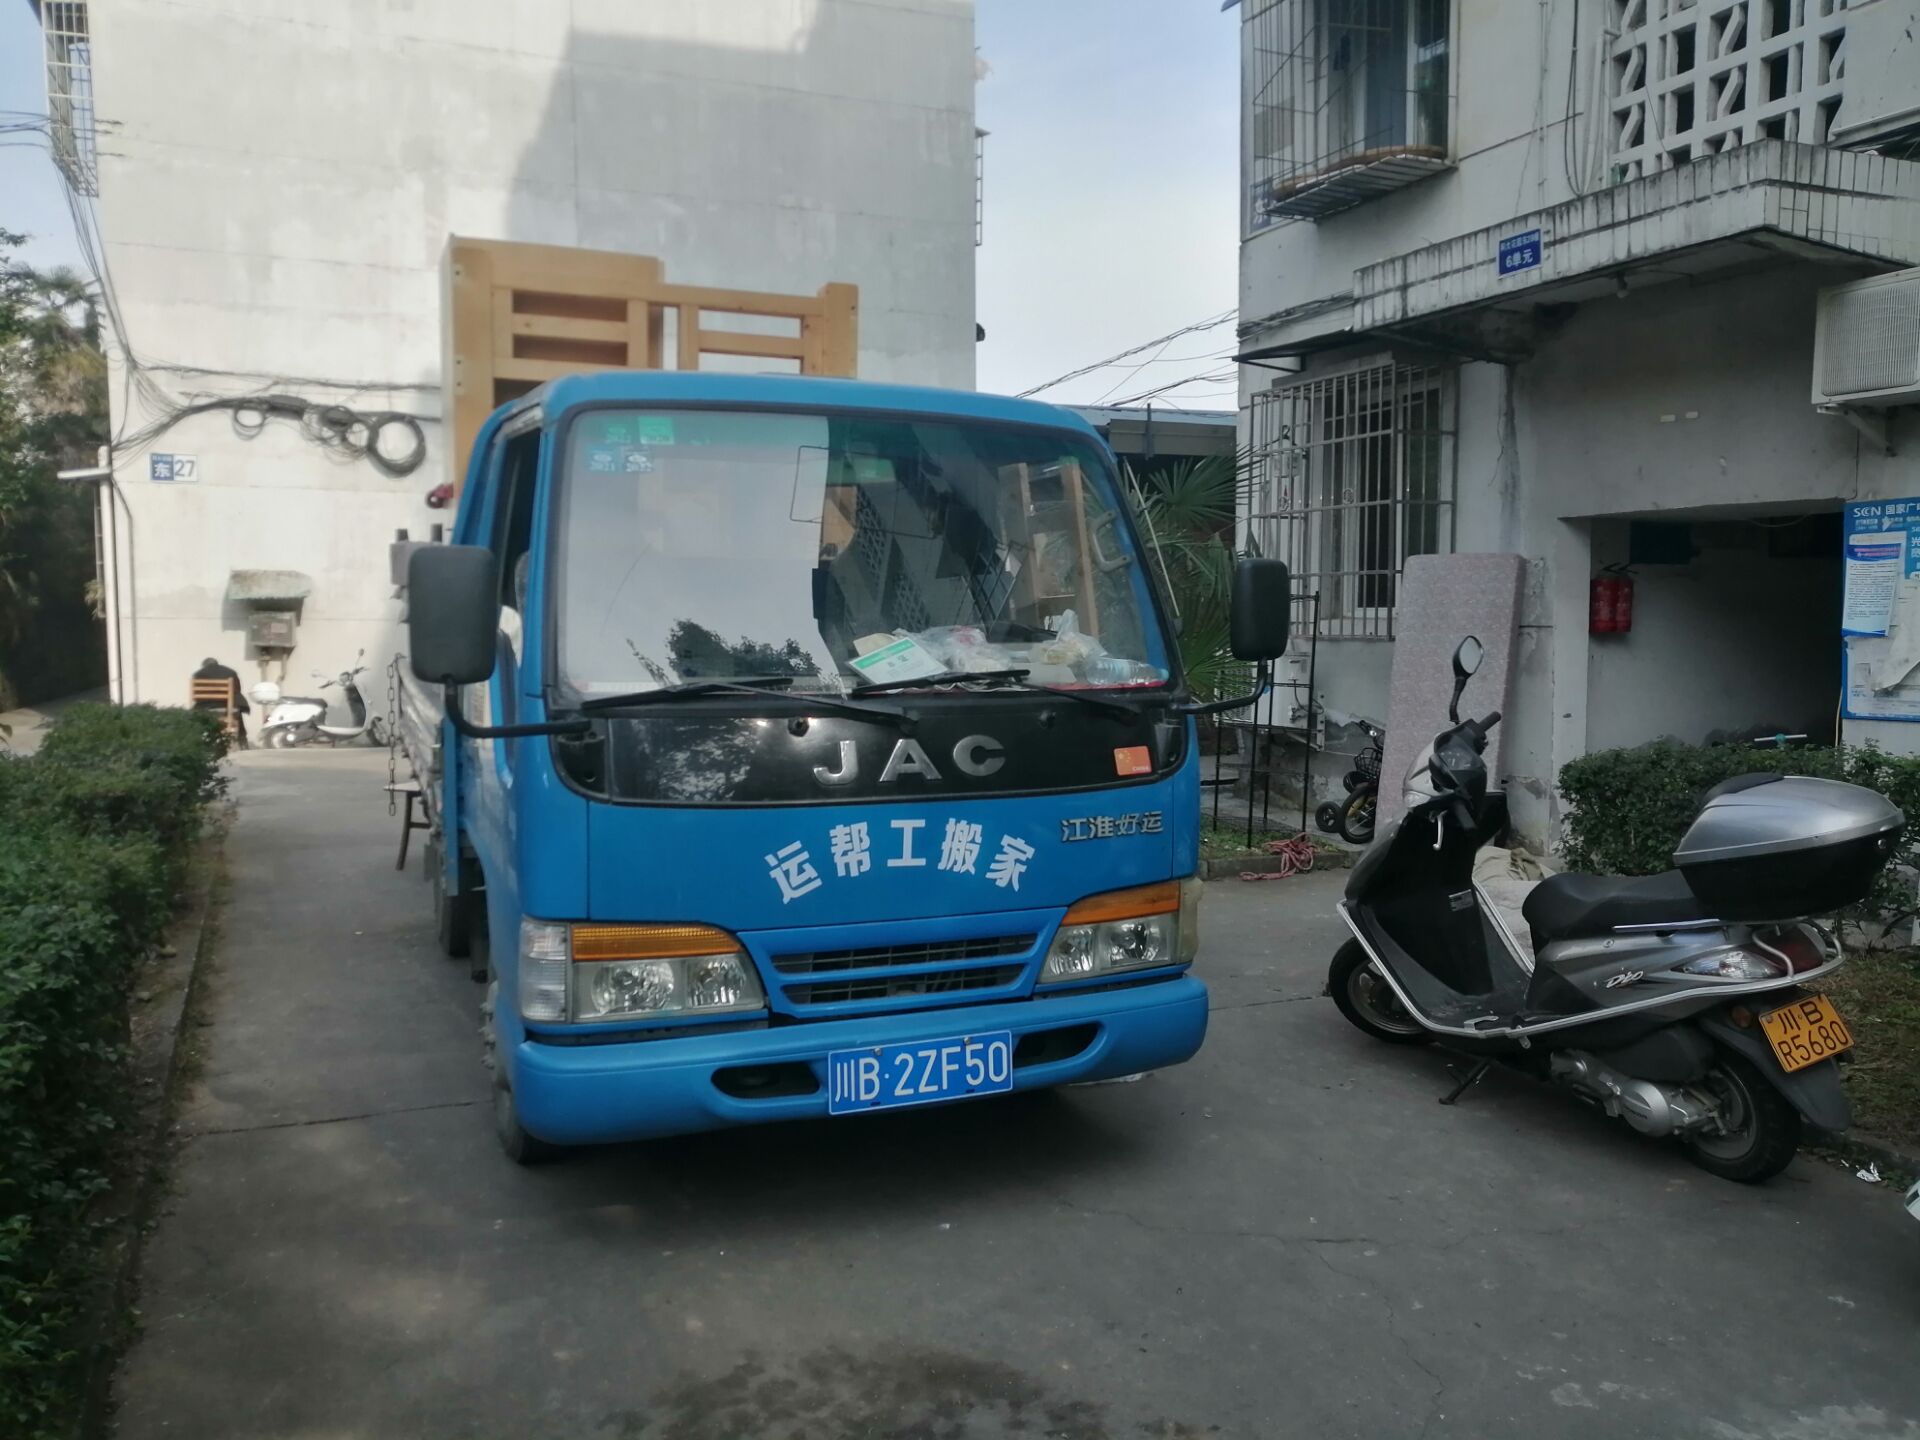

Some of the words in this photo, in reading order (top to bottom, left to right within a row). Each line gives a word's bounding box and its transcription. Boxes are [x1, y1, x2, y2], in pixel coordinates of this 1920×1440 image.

[174, 459, 195, 477] 27
[813, 735, 1006, 785] JAC
[1061, 810, 1164, 842] 江淮好运
[764, 817, 1036, 905] 运帮工搬家
[1777, 1020, 1849, 1069] R5680
